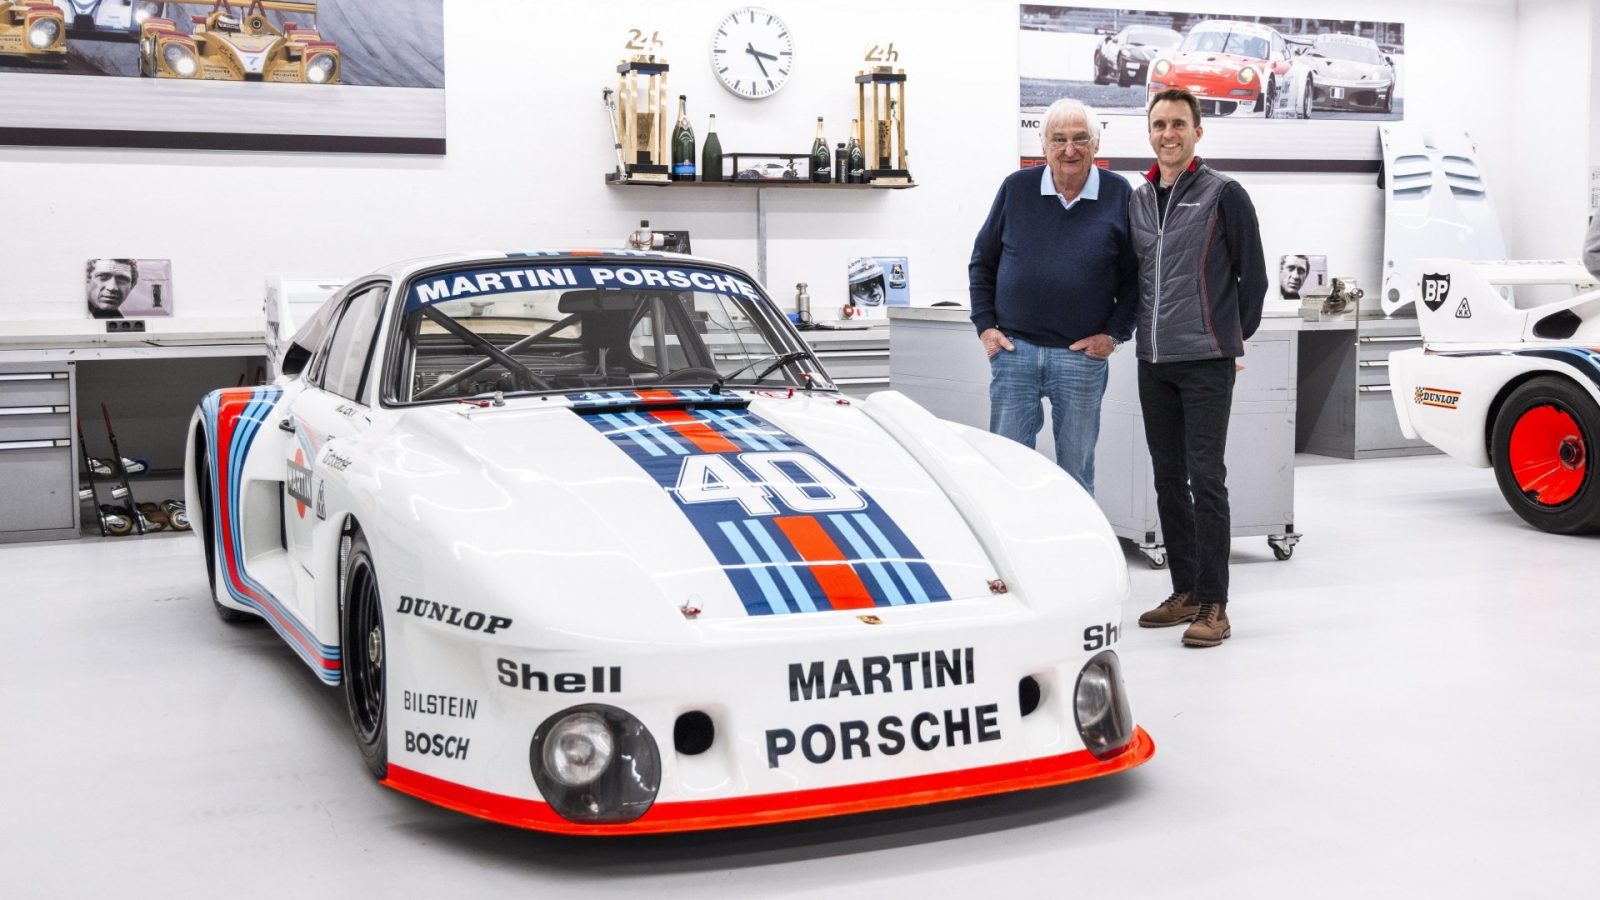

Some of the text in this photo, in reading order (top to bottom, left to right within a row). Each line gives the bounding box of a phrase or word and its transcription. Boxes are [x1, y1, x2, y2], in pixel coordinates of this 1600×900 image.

[416, 267, 759, 303] MARTINI PORSCHE
[1424, 279, 1449, 302] BP
[1423, 392, 1459, 405] DUNLOP
[674, 452, 868, 516] 40
[397, 595, 512, 634] DUNLOP
[497, 657, 622, 693] Shell
[788, 647, 975, 701] MARTINI
[404, 690, 478, 719] BILSTEIN
[405, 730, 470, 760] BOSCH
[765, 703, 1002, 768] PORSCHE
